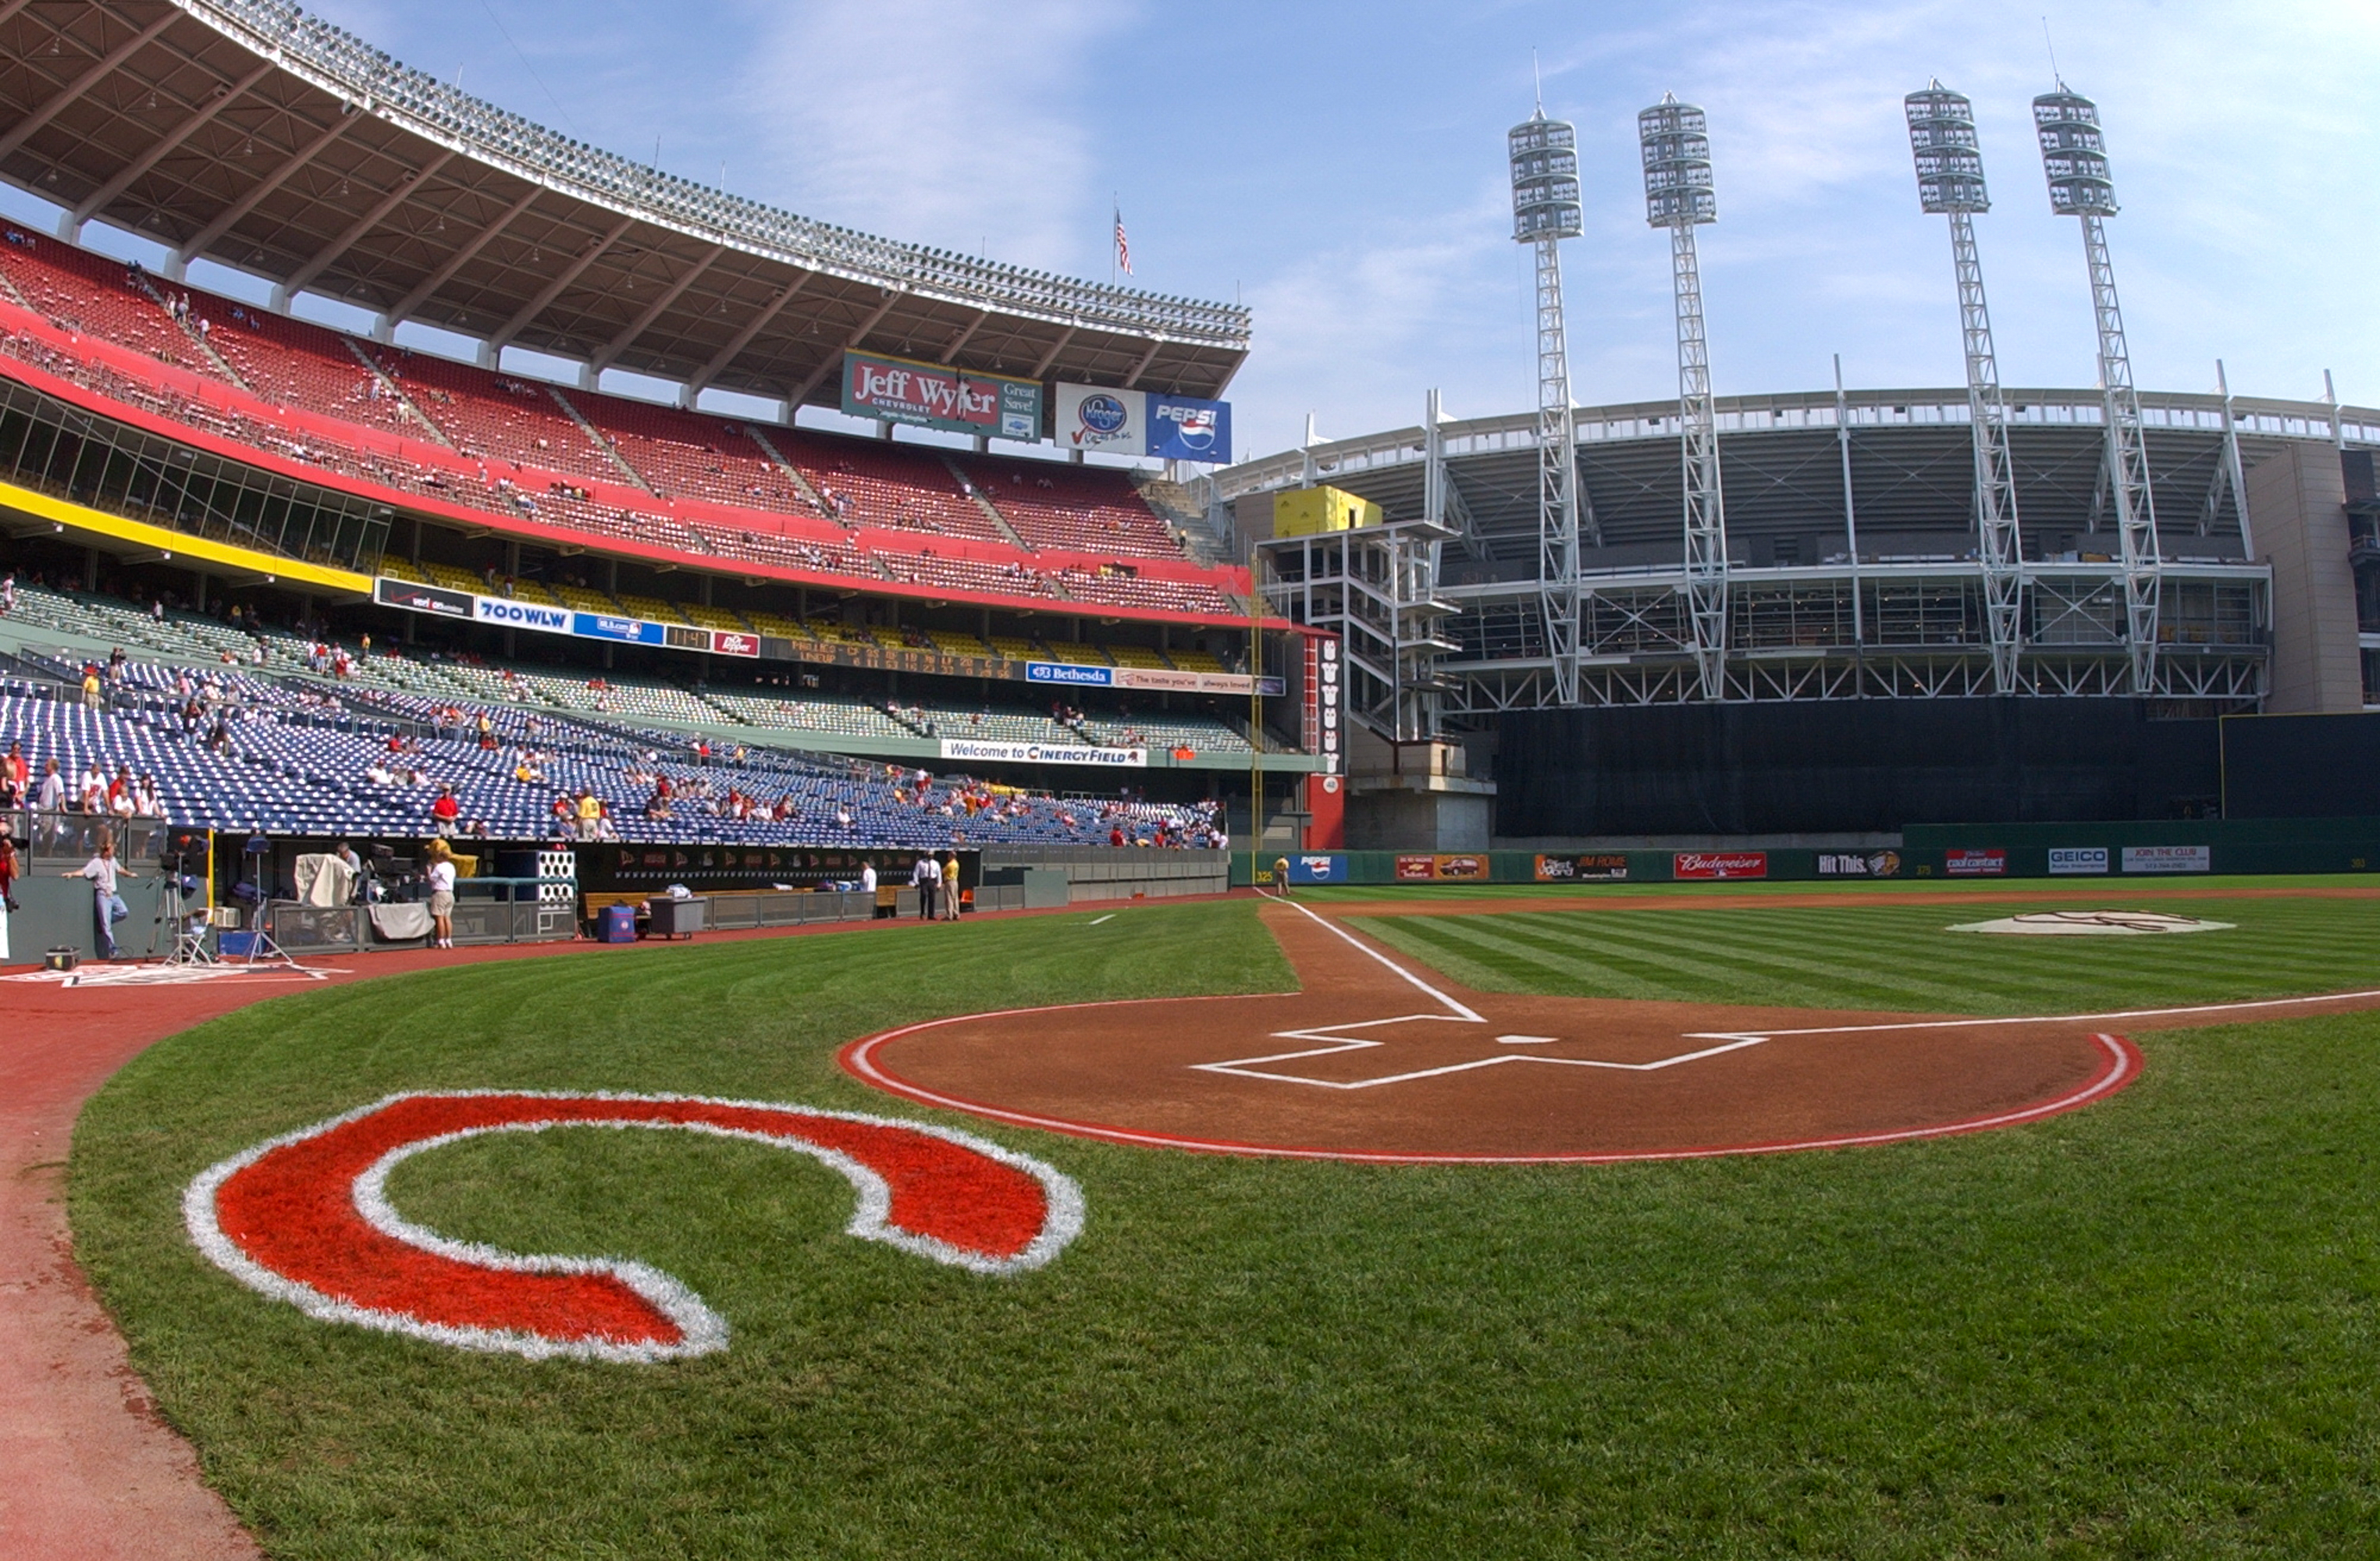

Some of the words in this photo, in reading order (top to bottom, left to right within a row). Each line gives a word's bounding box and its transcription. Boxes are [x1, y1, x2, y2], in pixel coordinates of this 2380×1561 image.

[856, 366, 910, 400] Jeff
[916, 376, 995, 415] Wyer
[1004, 383, 1036, 398] Great
[872, 397, 930, 414] CHEVROLET
[1004, 398, 1033, 412] Save!
[1086, 400, 1122, 428] Kroger
[1156, 404, 1217, 425] PEPSI
[413, 596, 444, 610] verizon
[1053, 667, 1106, 682] Bethesda
[950, 742, 1008, 759] Welcome
[1012, 747, 1024, 759] to
[1300, 856, 1332, 866] PEPSI
[1679, 854, 1762, 871] Budweiser
[1819, 855, 1837, 873] Hit
[2051, 852, 2105, 862] GEICO
